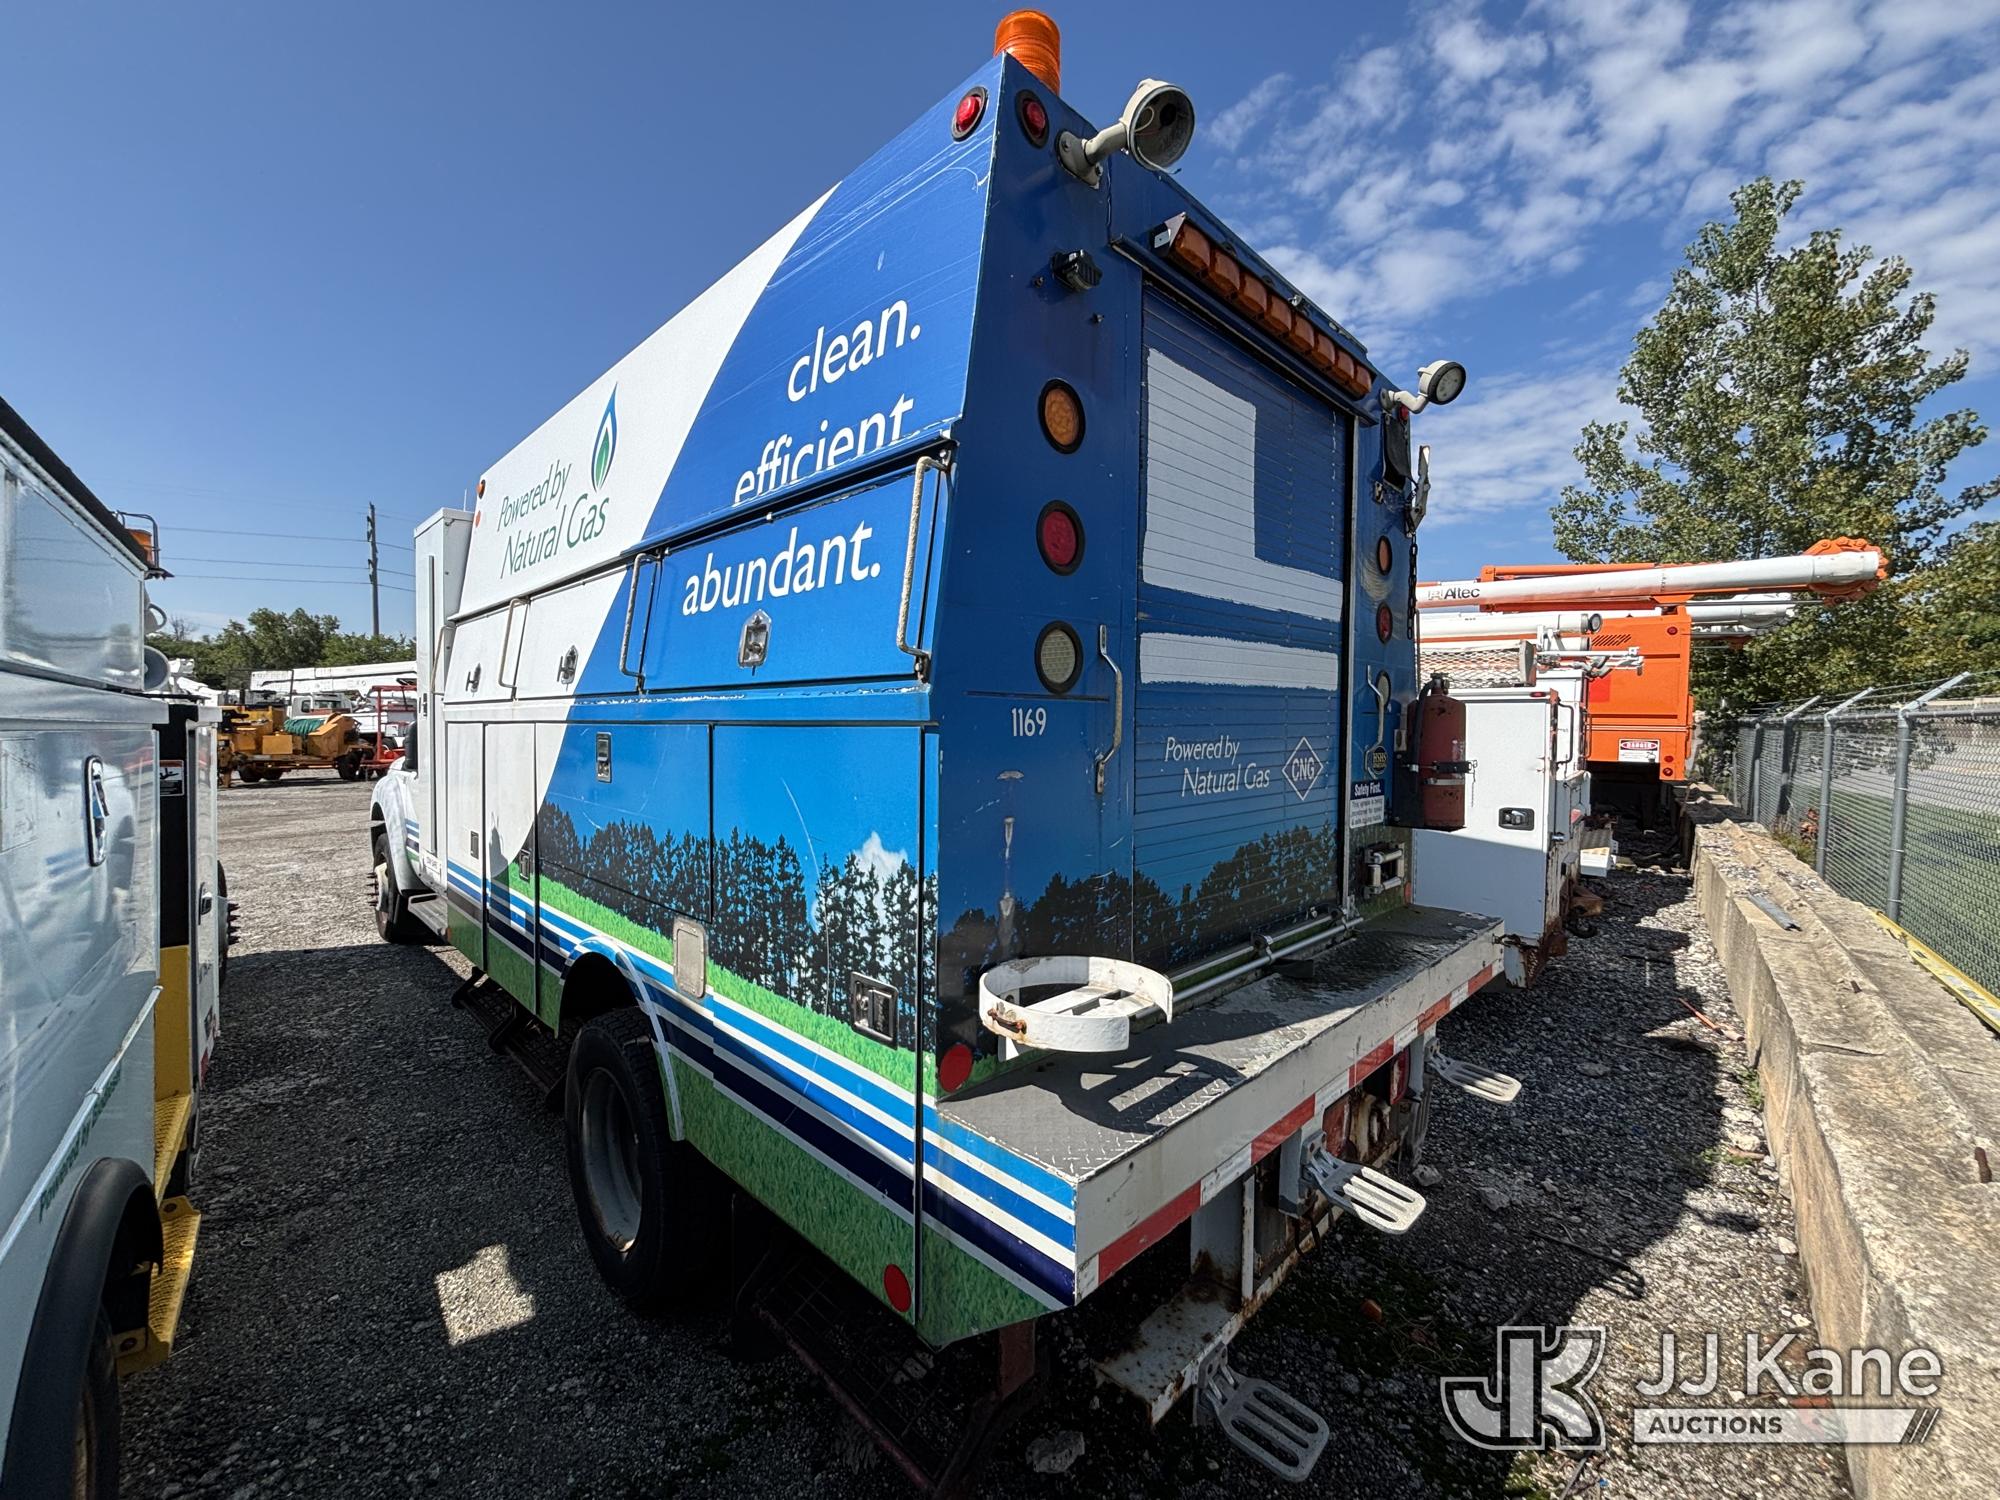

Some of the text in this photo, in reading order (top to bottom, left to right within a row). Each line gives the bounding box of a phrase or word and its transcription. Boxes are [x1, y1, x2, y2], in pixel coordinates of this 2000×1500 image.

[787, 299, 921, 402] clean.
[733, 393, 914, 507] efficient
[497, 459, 572, 532] Powered by
[500, 493, 610, 579] Natural Gas
[682, 520, 881, 616] abundant.
[1444, 587, 1481, 600] Altec
[1011, 707, 1047, 737] 1169
[1164, 735, 1240, 765] Powered by
[1182, 763, 1270, 797] Natural Gas
[1291, 757, 1315, 782] CNG
[1354, 783, 1369, 797] Safety
